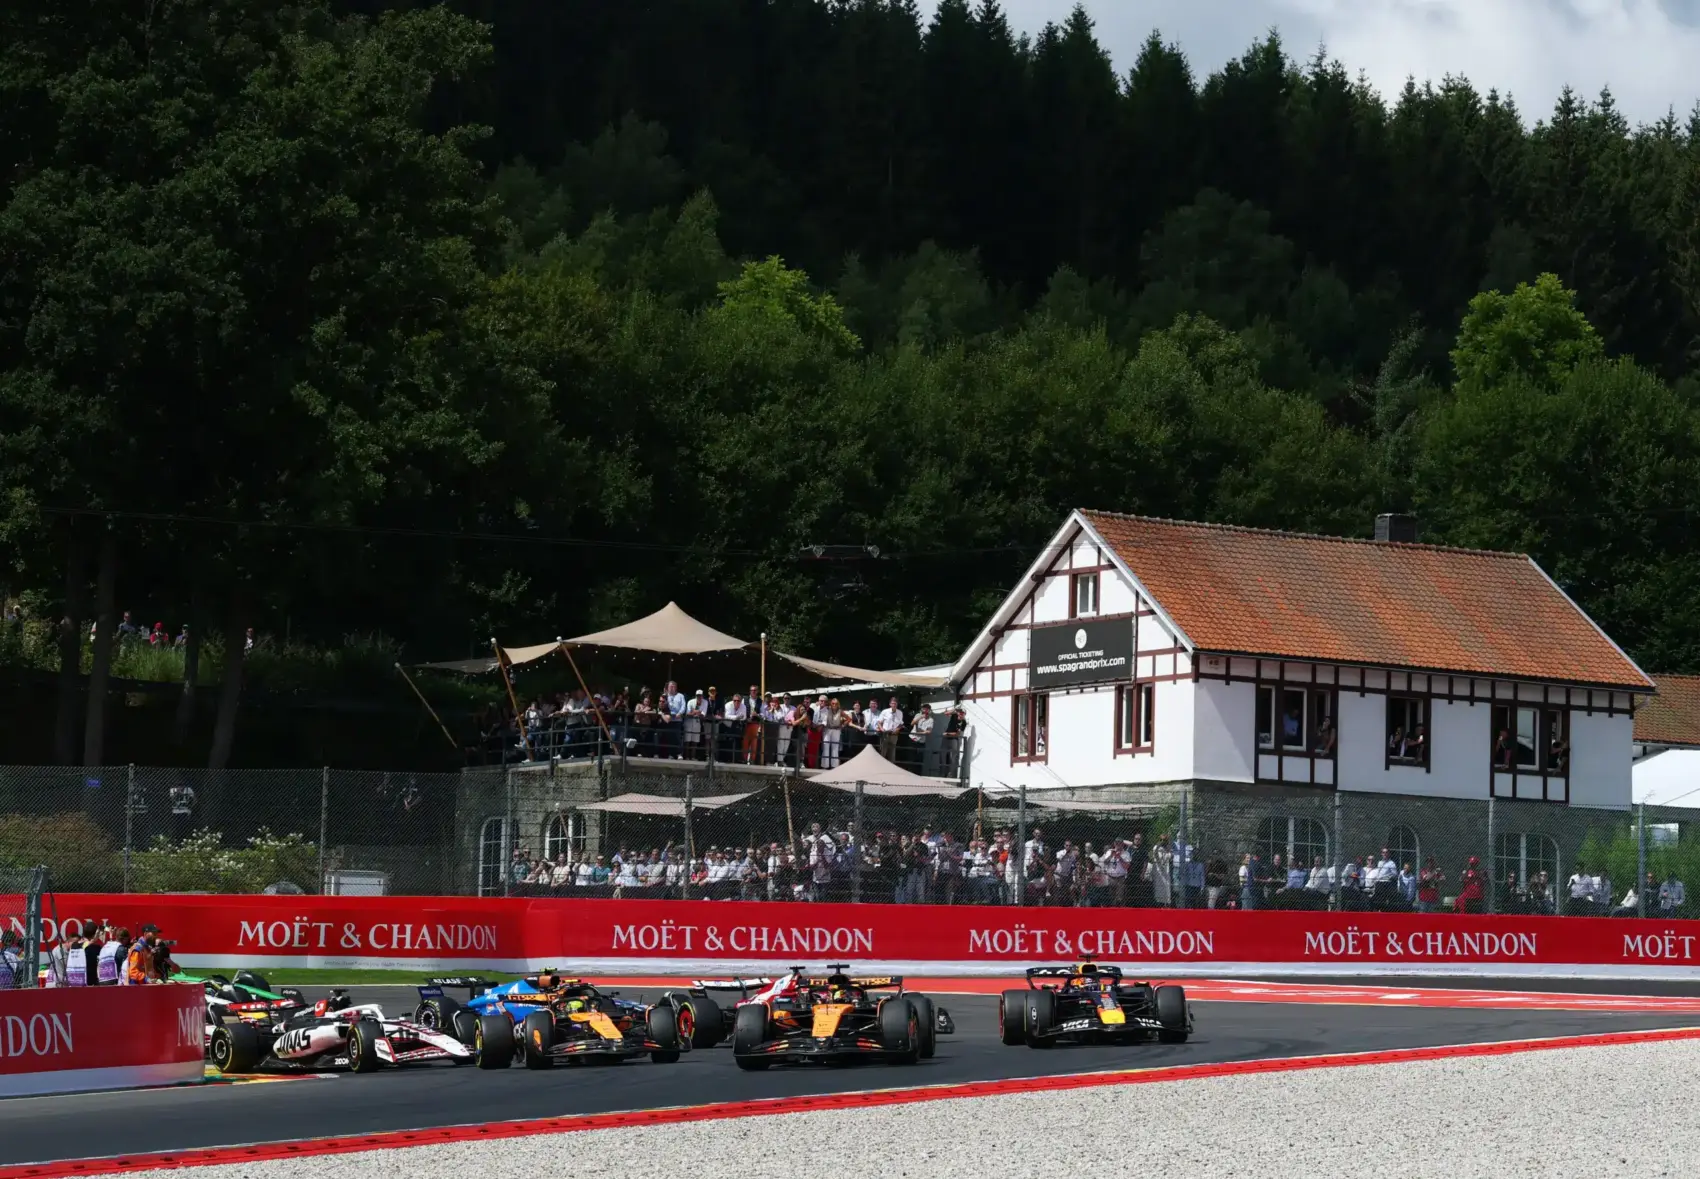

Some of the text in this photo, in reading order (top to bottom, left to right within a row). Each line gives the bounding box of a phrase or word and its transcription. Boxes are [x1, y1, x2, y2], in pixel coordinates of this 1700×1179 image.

[1036, 657, 1125, 674] www.spagrandprix.com
[1057, 649, 1104, 661] OFFICIAL TICKETING
[237, 915, 497, 951] MOËT & CHANDON
[612, 919, 873, 953] MOËT & CHANDON
[968, 923, 1214, 955] MOËT & CHANDON
[1304, 926, 1538, 957] MOËT & CHANDON
[1622, 929, 1697, 959] MOËT
[0, 1012, 74, 1058] DON
